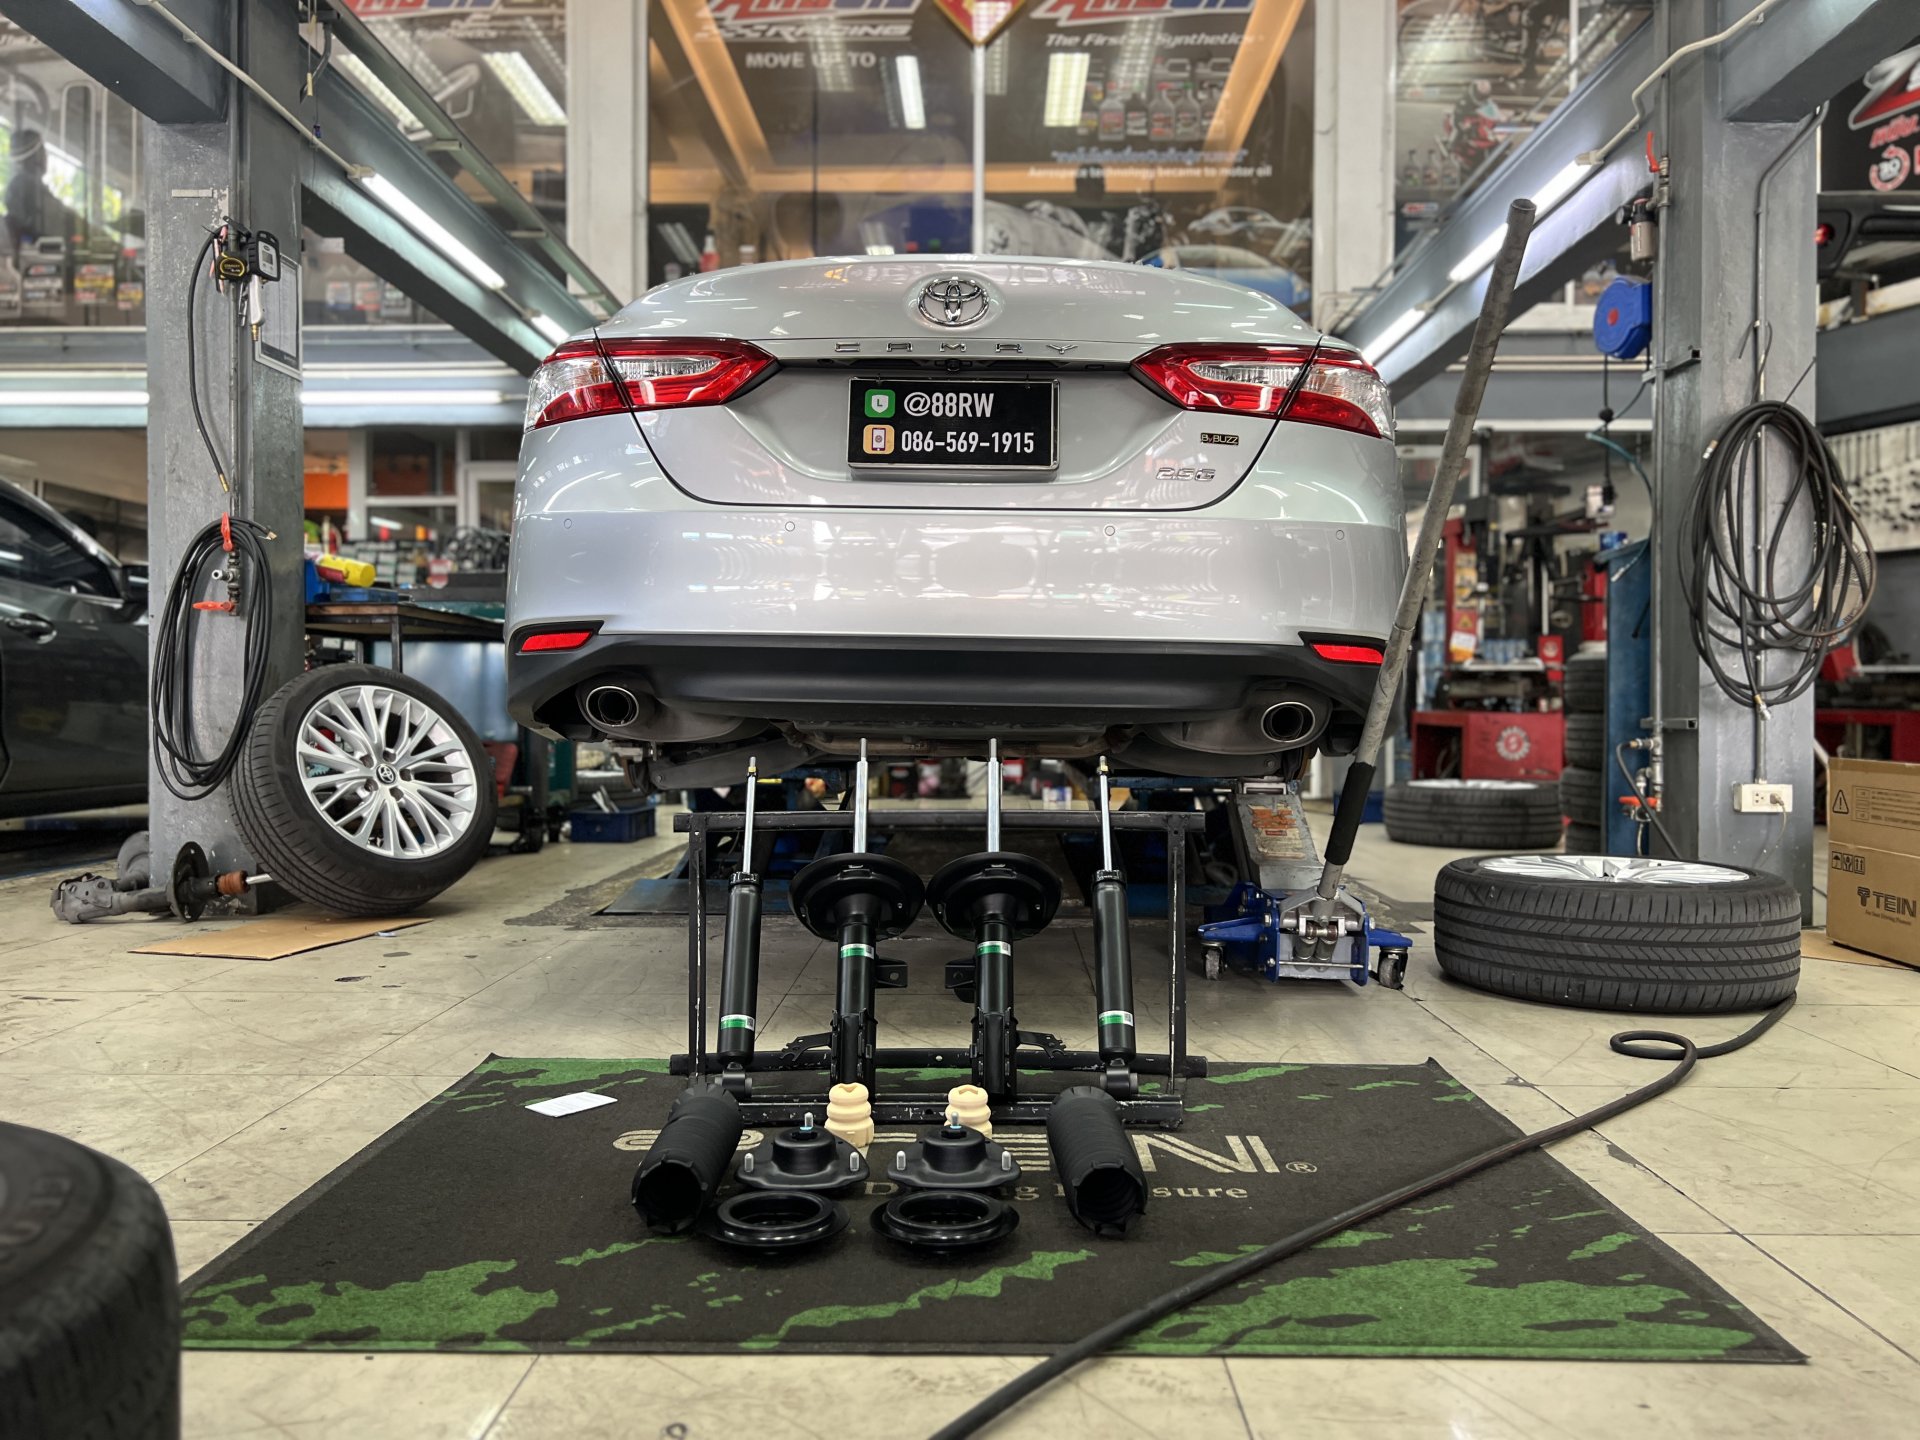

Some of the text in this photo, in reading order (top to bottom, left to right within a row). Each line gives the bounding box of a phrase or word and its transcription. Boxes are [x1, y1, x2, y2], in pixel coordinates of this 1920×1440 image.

[1045, 33, 1081, 47] The
[745, 52, 805, 68] MOVE
[848, 51, 876, 68] TO
[1256, 165, 1272, 178] oil
[835, 342, 1078, 353] CAMRY
[904, 392, 994, 418] @88RW
[902, 430, 1035, 453] 086-569-1915
[1872, 891, 1917, 918] TEIN
